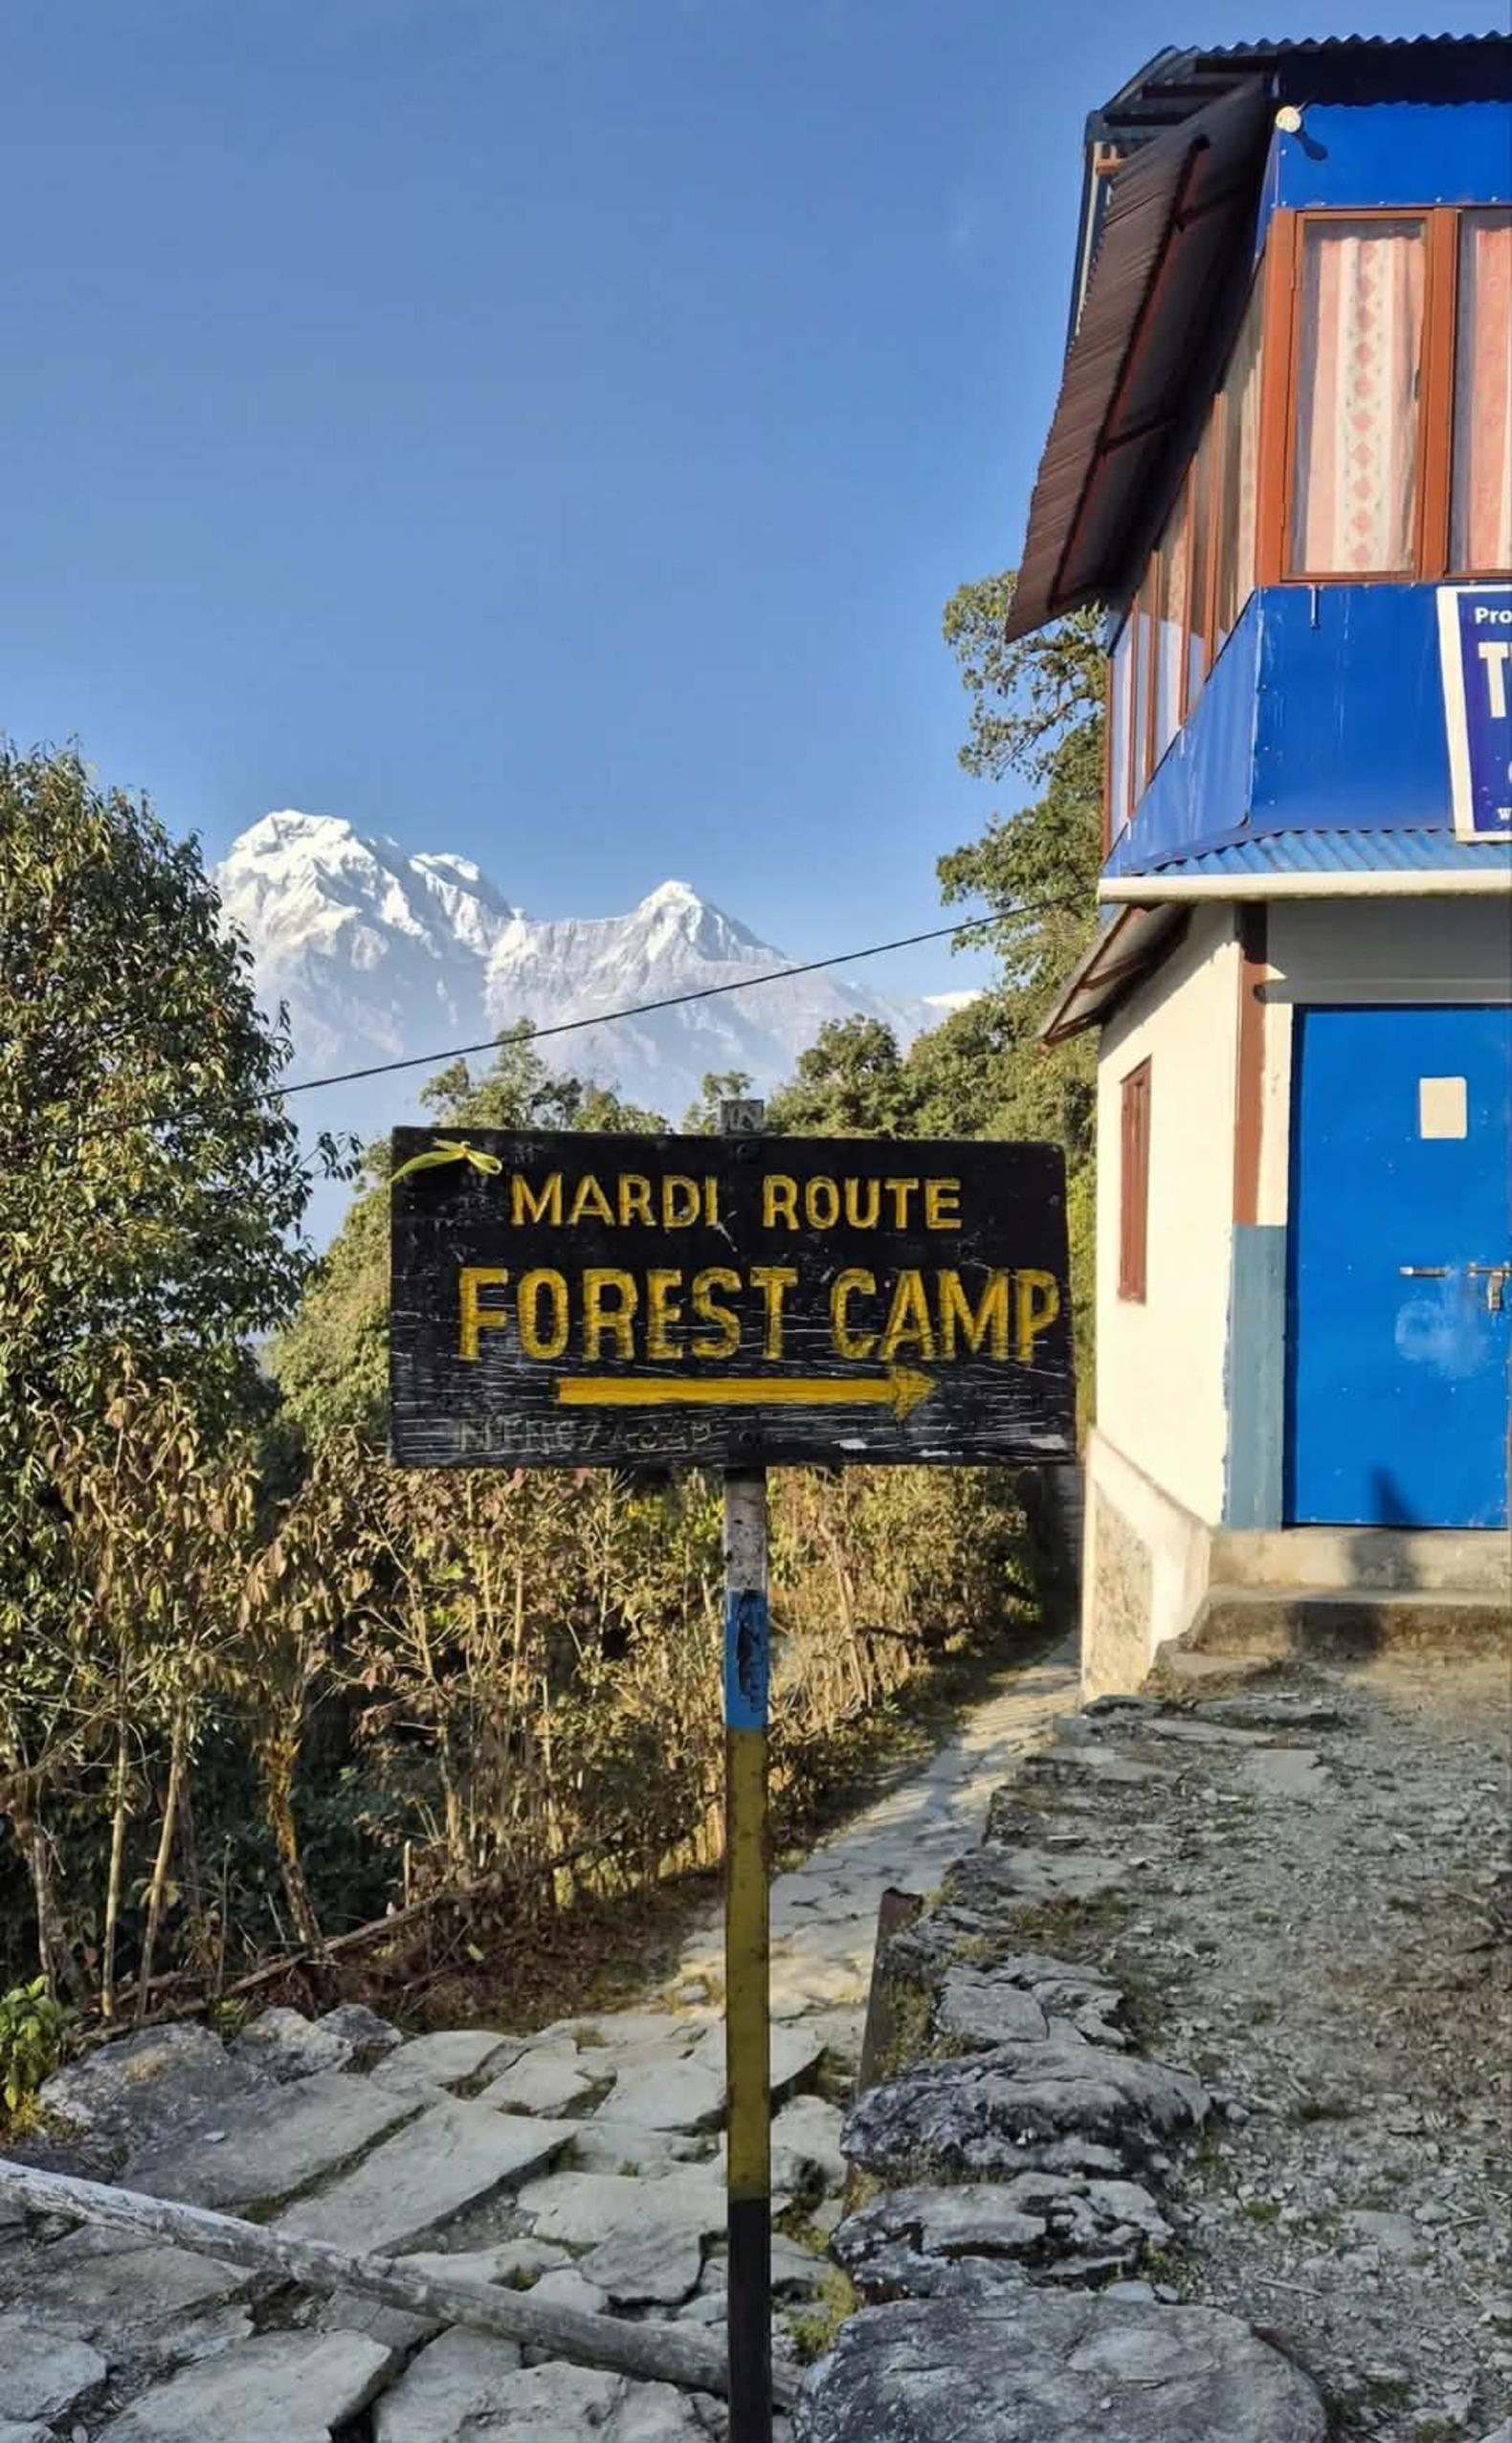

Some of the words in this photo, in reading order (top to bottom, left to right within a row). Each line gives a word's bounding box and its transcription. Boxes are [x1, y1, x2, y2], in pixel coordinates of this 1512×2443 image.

[1478, 642, 1512, 718] T
[511, 1173, 719, 1228] MARDI
[763, 1174, 963, 1231] ROUTE
[458, 1267, 798, 1363] FOREST
[830, 1268, 1061, 1365] CAMP
